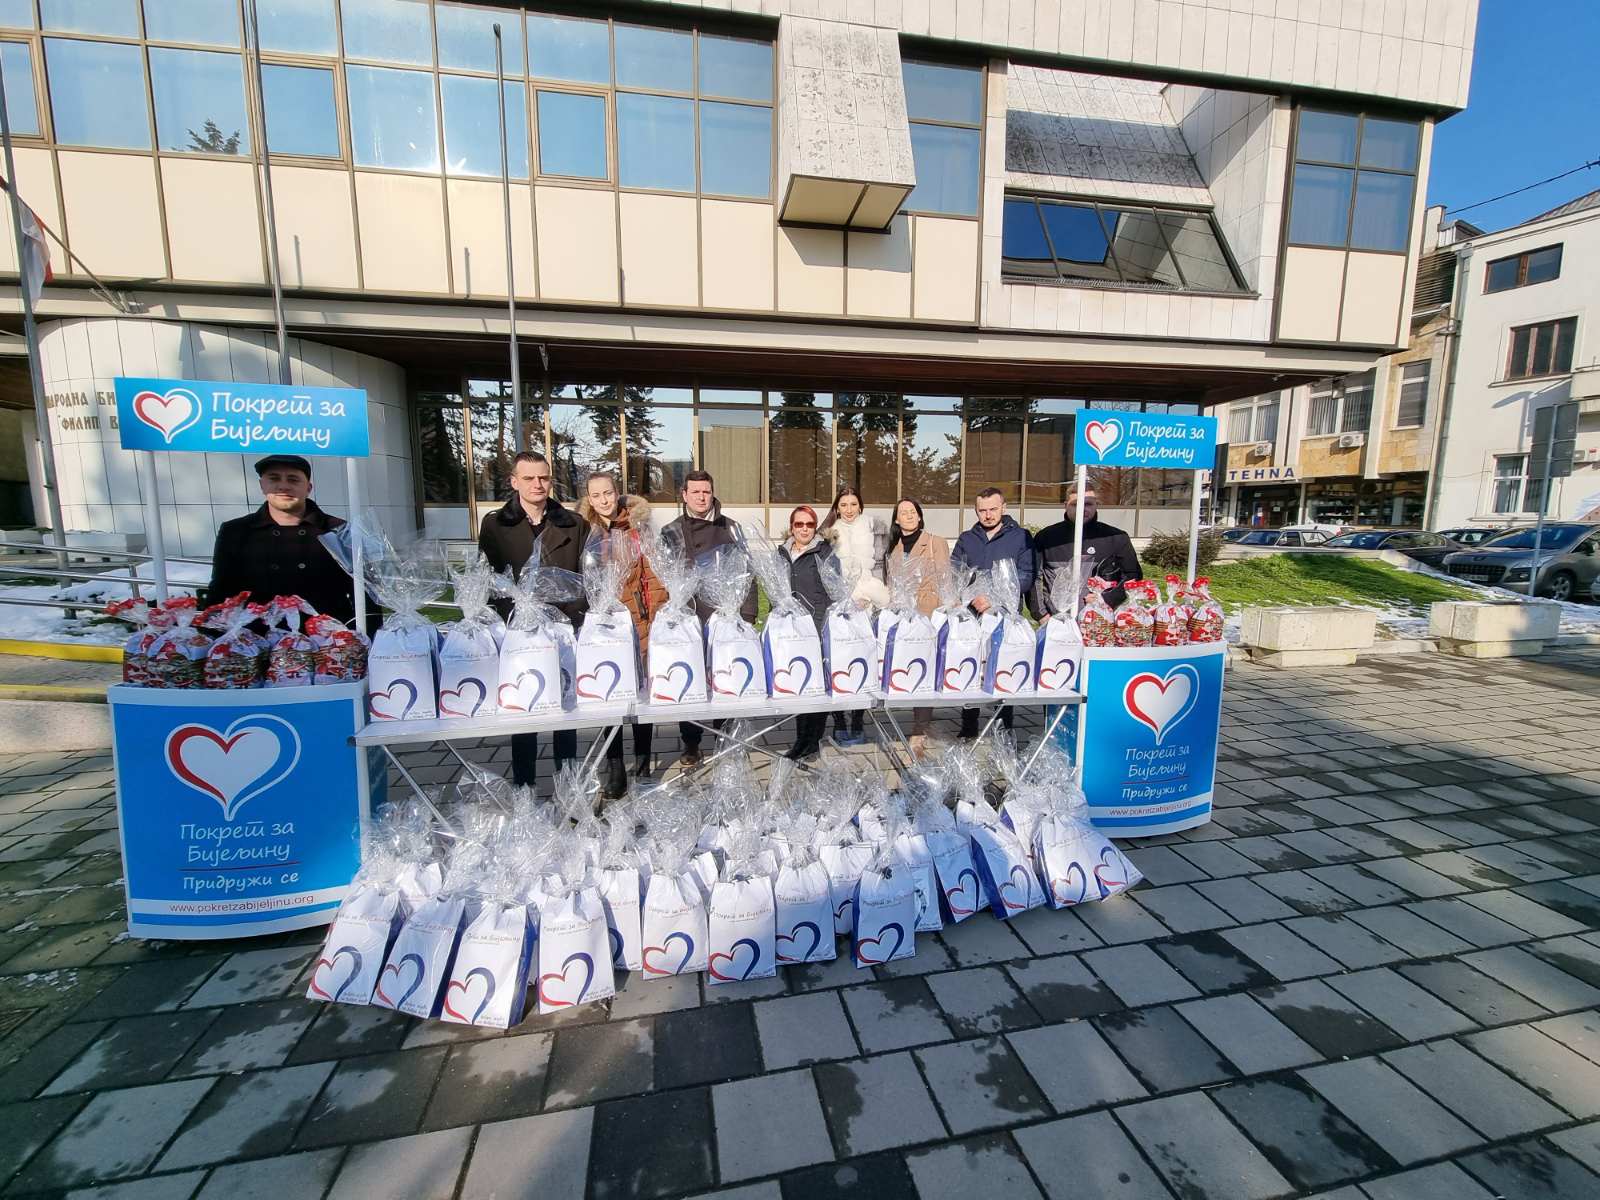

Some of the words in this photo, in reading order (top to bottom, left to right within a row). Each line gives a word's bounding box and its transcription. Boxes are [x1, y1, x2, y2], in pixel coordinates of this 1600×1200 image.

[319, 400, 346, 417] за
[211, 418, 331, 449] Бијељину
[1189, 428, 1205, 440] за
[1125, 442, 1195, 464] Бијељину
[1229, 467, 1295, 480] TEHNA
[1178, 745, 1190, 756] за
[1128, 762, 1187, 780] Бијељину
[1122, 786, 1175, 801] Придружи
[1178, 783, 1188, 792] се
[270, 822, 295, 836] за
[187, 844, 290, 867] Бијељину
[183, 875, 273, 894] Придружи
[280, 872, 300, 884] се
[169, 894, 314, 913] www.pokretzabijeljinu.org
